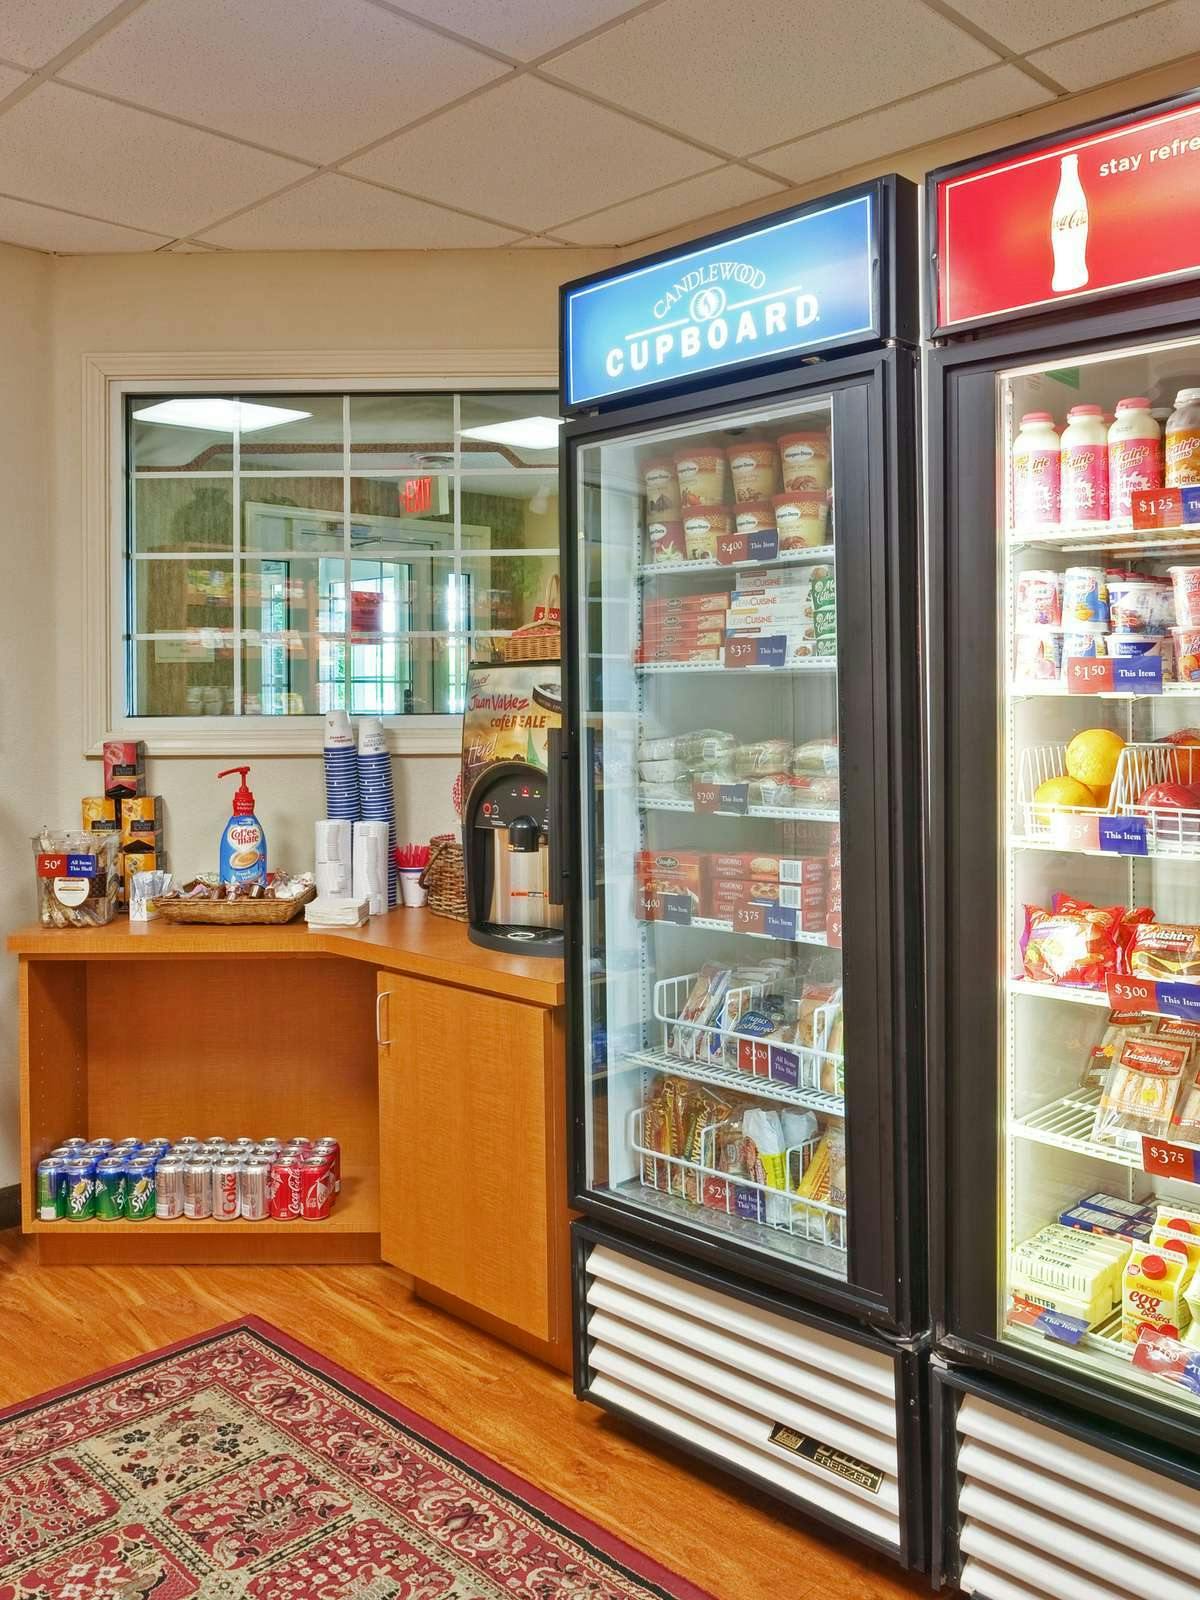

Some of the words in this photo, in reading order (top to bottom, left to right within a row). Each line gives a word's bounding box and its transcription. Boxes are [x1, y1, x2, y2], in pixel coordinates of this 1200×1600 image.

[1100, 154, 1142, 177] stay
[653, 262, 767, 319] CANDLEWOOD
[406, 478, 431, 512] EXIT
[539, 612, 557, 621] $00
[1119, 669, 1136, 677] This
[1138, 669, 1156, 677] Item
[468, 693, 491, 711] Juan
[491, 694, 530, 711] Valdez
[490, 714, 511, 732] café
[231, 828, 257, 841] Coffee
[237, 835, 259, 846] mate
[1104, 831, 1121, 839] This
[1123, 832, 1141, 840] Item
[44, 860, 61, 870] 50¢
[1162, 995, 1180, 1004] This
[1183, 998, 1200, 1006] Item
[1123, 1050, 1172, 1066] Landshire
[223, 1173, 237, 1215] Coke
[288, 1167, 301, 1214] Coca-Cola
[1063, 1234, 1096, 1246] BUTTER
[1038, 1255, 1071, 1268] BUTTER
[1024, 1293, 1056, 1310] BUTTER
[1129, 1290, 1161, 1313] egg
[1045, 1316, 1061, 1327] This
[1062, 1322, 1078, 1332] Item
[813, 1452, 872, 1487] FREEZER
